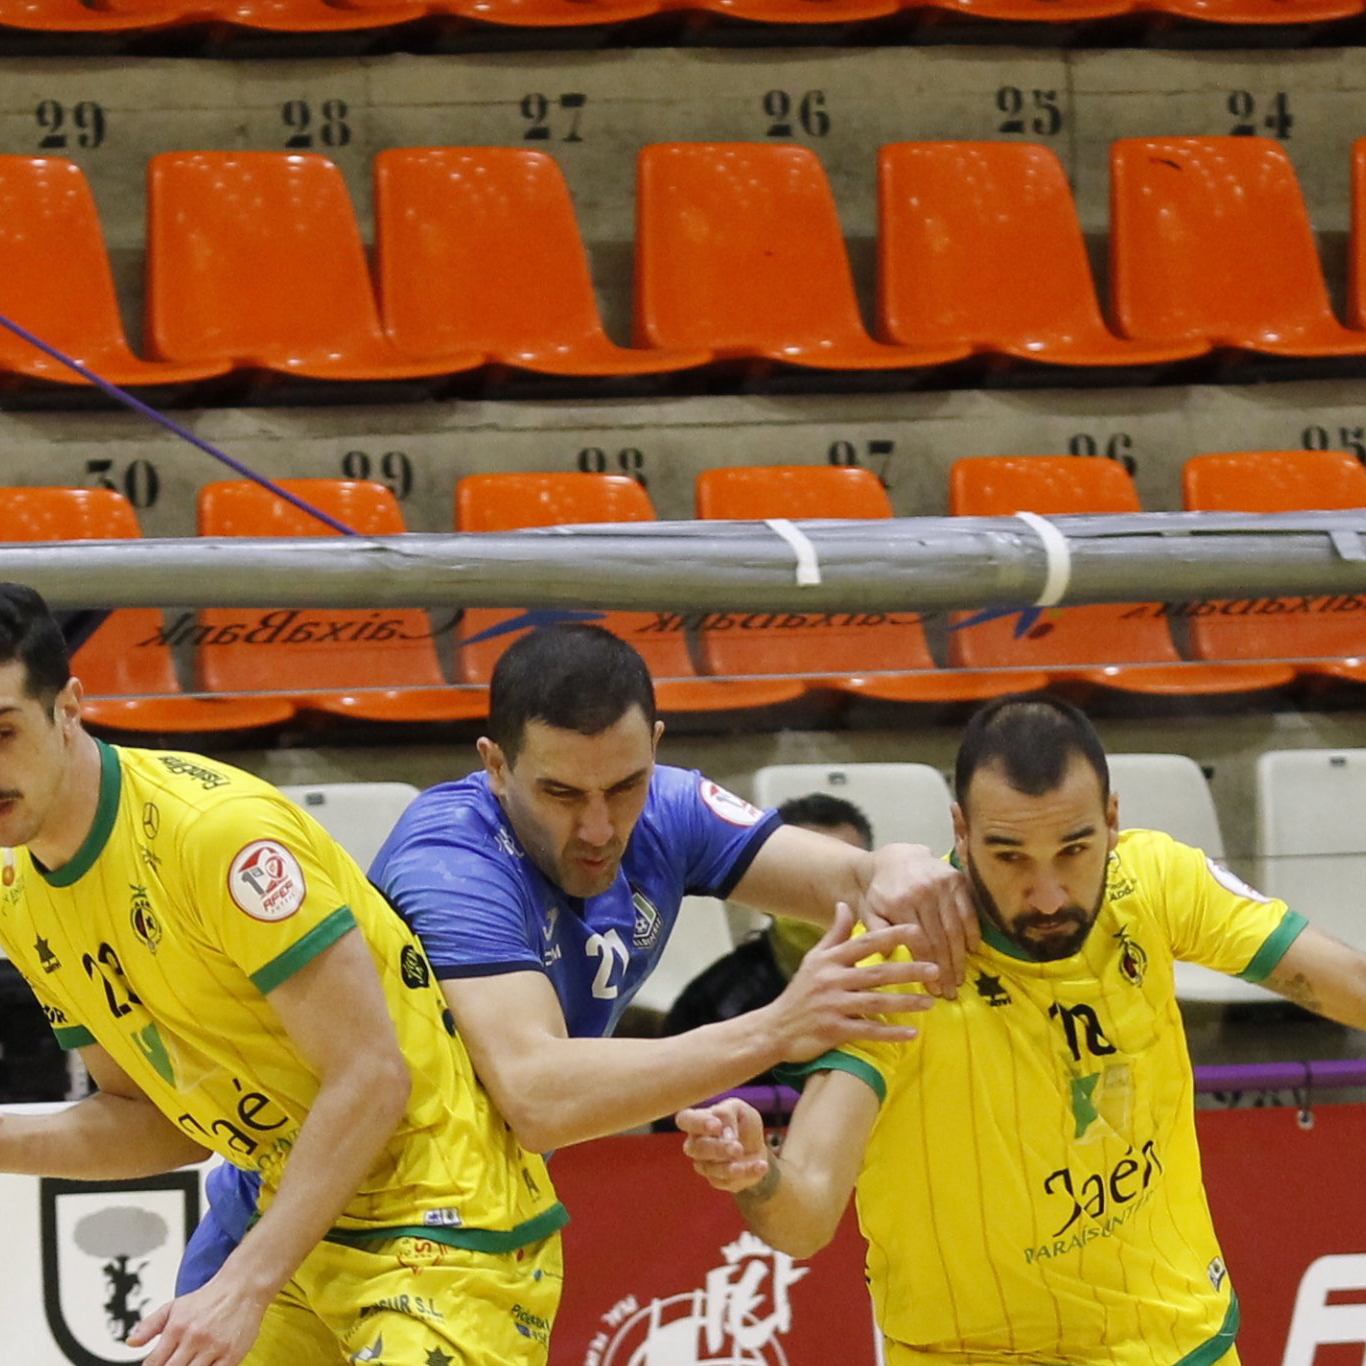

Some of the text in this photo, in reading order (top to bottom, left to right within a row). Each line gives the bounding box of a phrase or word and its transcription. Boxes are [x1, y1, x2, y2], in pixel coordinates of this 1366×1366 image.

[35, 100, 107, 150] 29
[282, 99, 352, 150] 28
[519, 92, 587, 143] 27
[763, 89, 832, 139] 26
[996, 86, 1065, 137] 25
[1227, 89, 1294, 141] 24
[1042, 1139, 1164, 1239] Jaén
